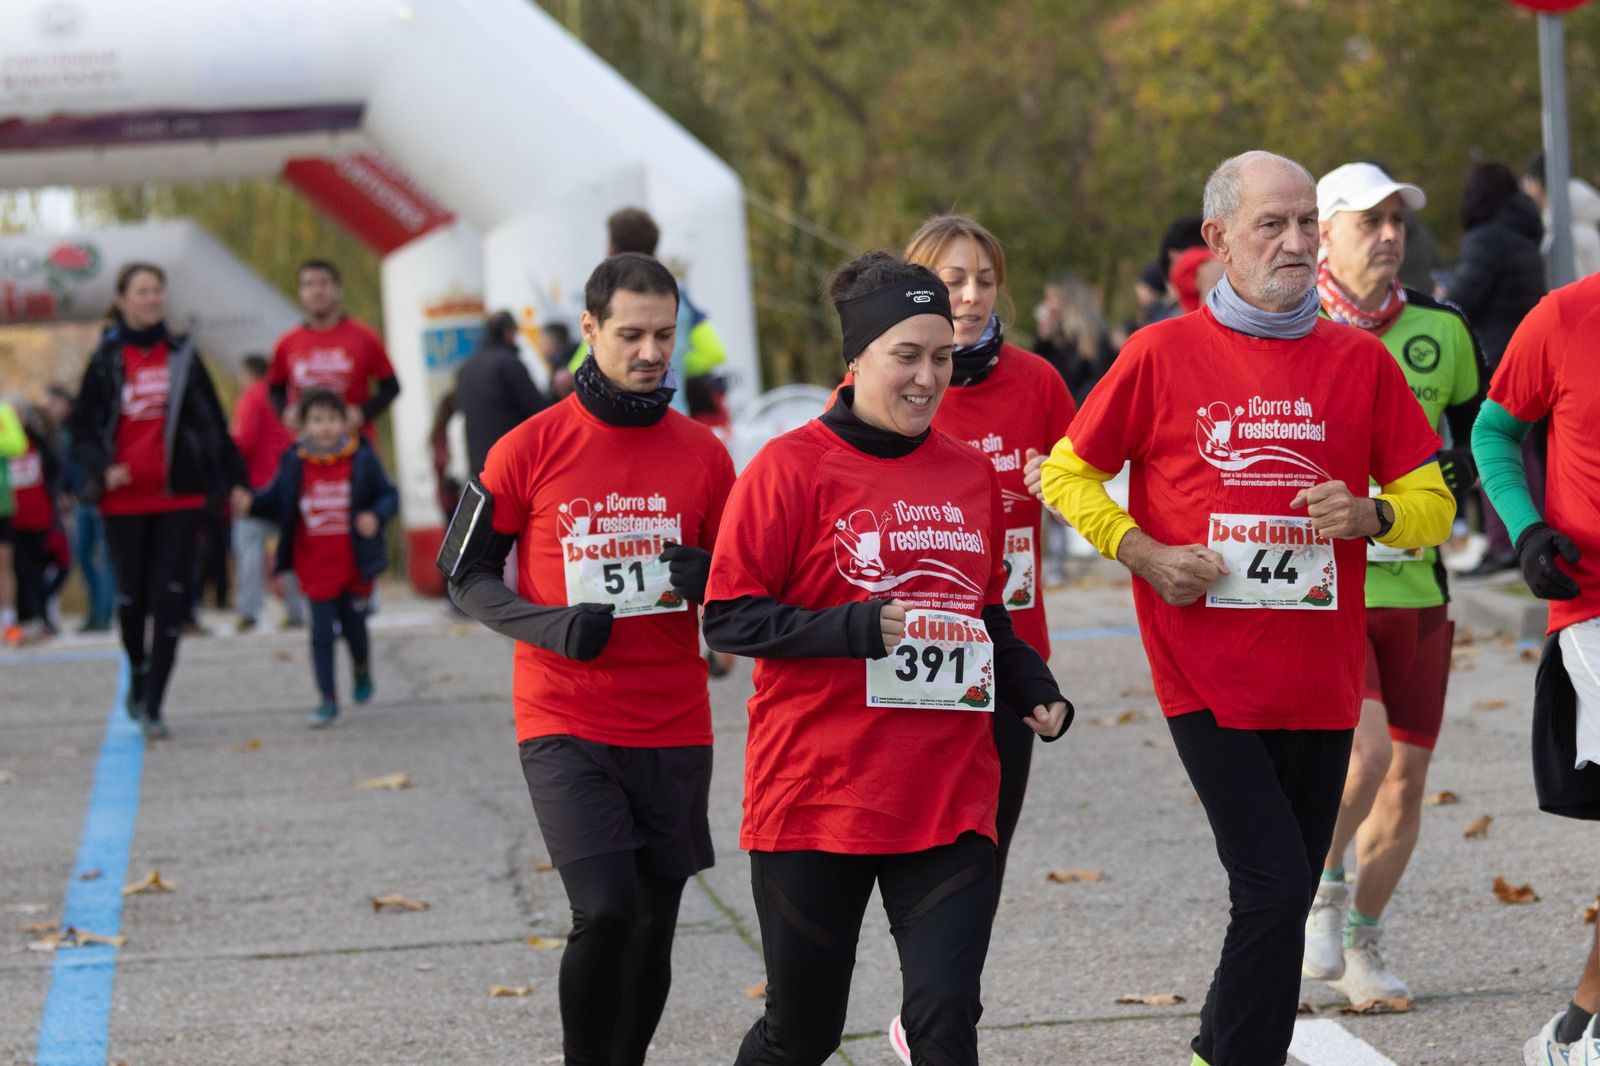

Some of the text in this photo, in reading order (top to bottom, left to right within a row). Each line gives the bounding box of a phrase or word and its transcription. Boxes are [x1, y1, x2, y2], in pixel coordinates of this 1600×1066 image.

[1248, 395, 1313, 418] ¡Corre sin
[1238, 418, 1326, 442] resistencias!
[982, 433, 1003, 453] sin
[606, 492, 666, 514] ¡Corre sin
[893, 499, 965, 525] ¡Corre sin
[597, 513, 681, 533] resistencias!
[888, 525, 985, 554] resistencias!
[602, 561, 645, 595] 51
[1246, 550, 1298, 584] 44
[932, 599, 941, 608] los
[941, 600, 974, 610] antibióticos!
[901, 615, 990, 643] dunia
[895, 644, 964, 684] 391
